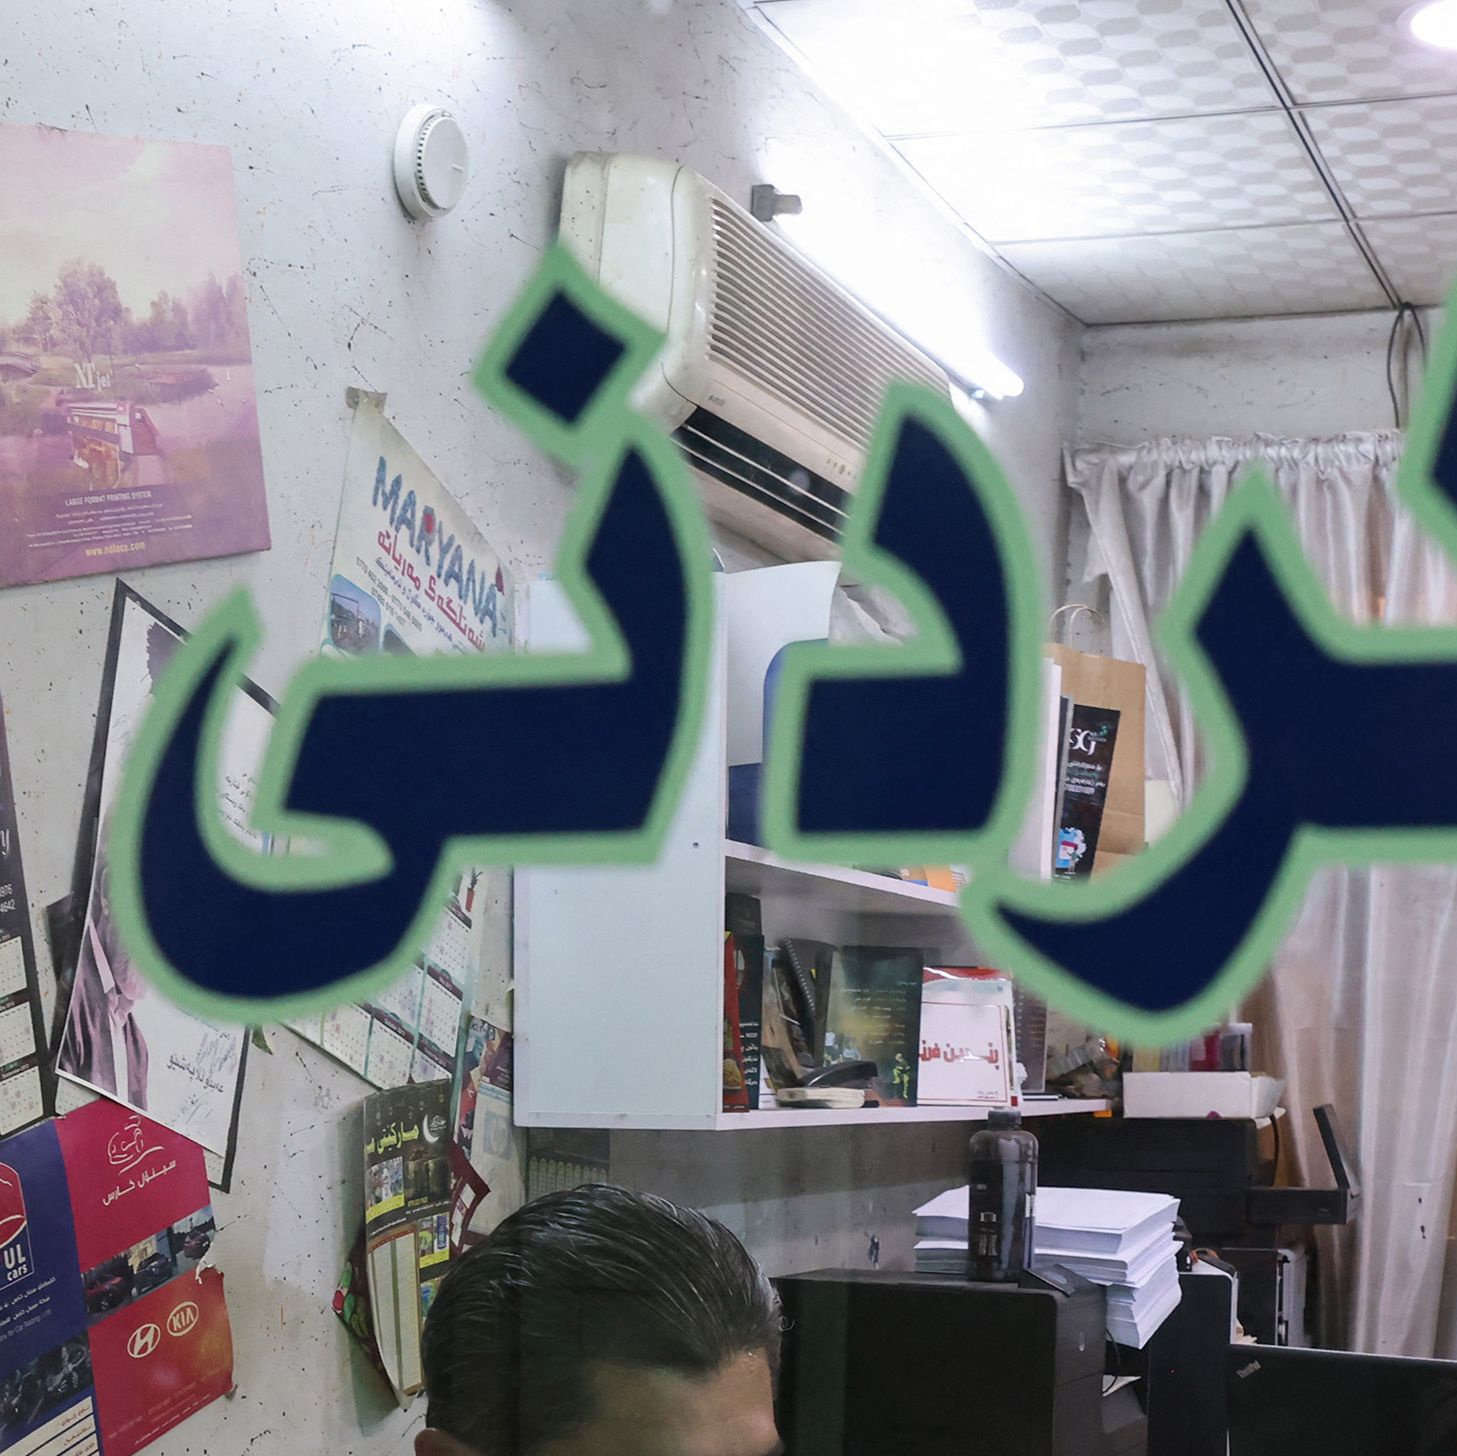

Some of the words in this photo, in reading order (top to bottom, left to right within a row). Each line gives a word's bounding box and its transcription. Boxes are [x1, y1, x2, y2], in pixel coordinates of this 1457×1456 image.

[372, 456, 497, 637] MARYANA
[7, 1264, 28, 1282] cars
[171, 1306, 195, 1332] KIA
